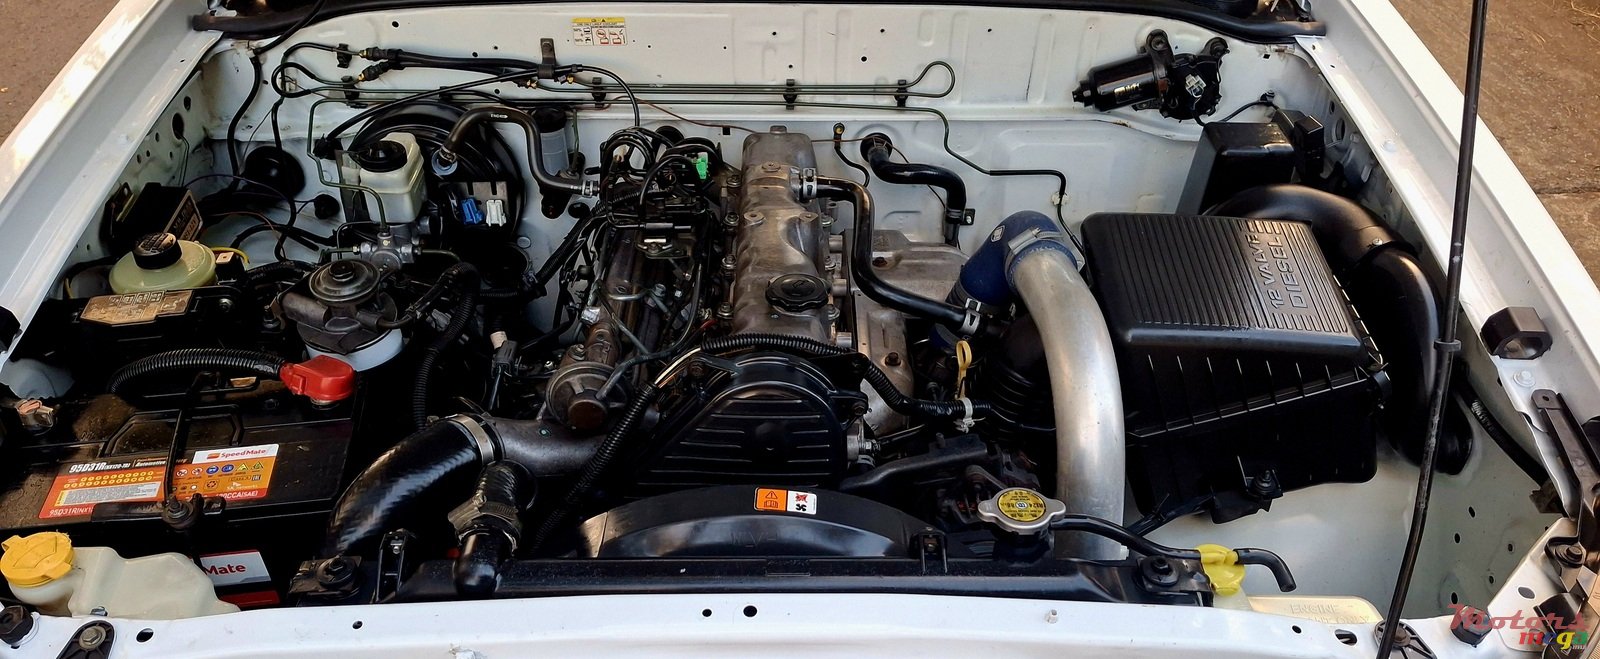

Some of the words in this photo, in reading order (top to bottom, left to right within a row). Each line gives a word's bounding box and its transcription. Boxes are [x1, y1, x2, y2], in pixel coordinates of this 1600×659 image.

[1245, 233, 1276, 285] VALVE
[1268, 236, 1308, 309] DIESEL
[1269, 289, 1284, 309] 12
[221, 449, 266, 459] SpeedMate
